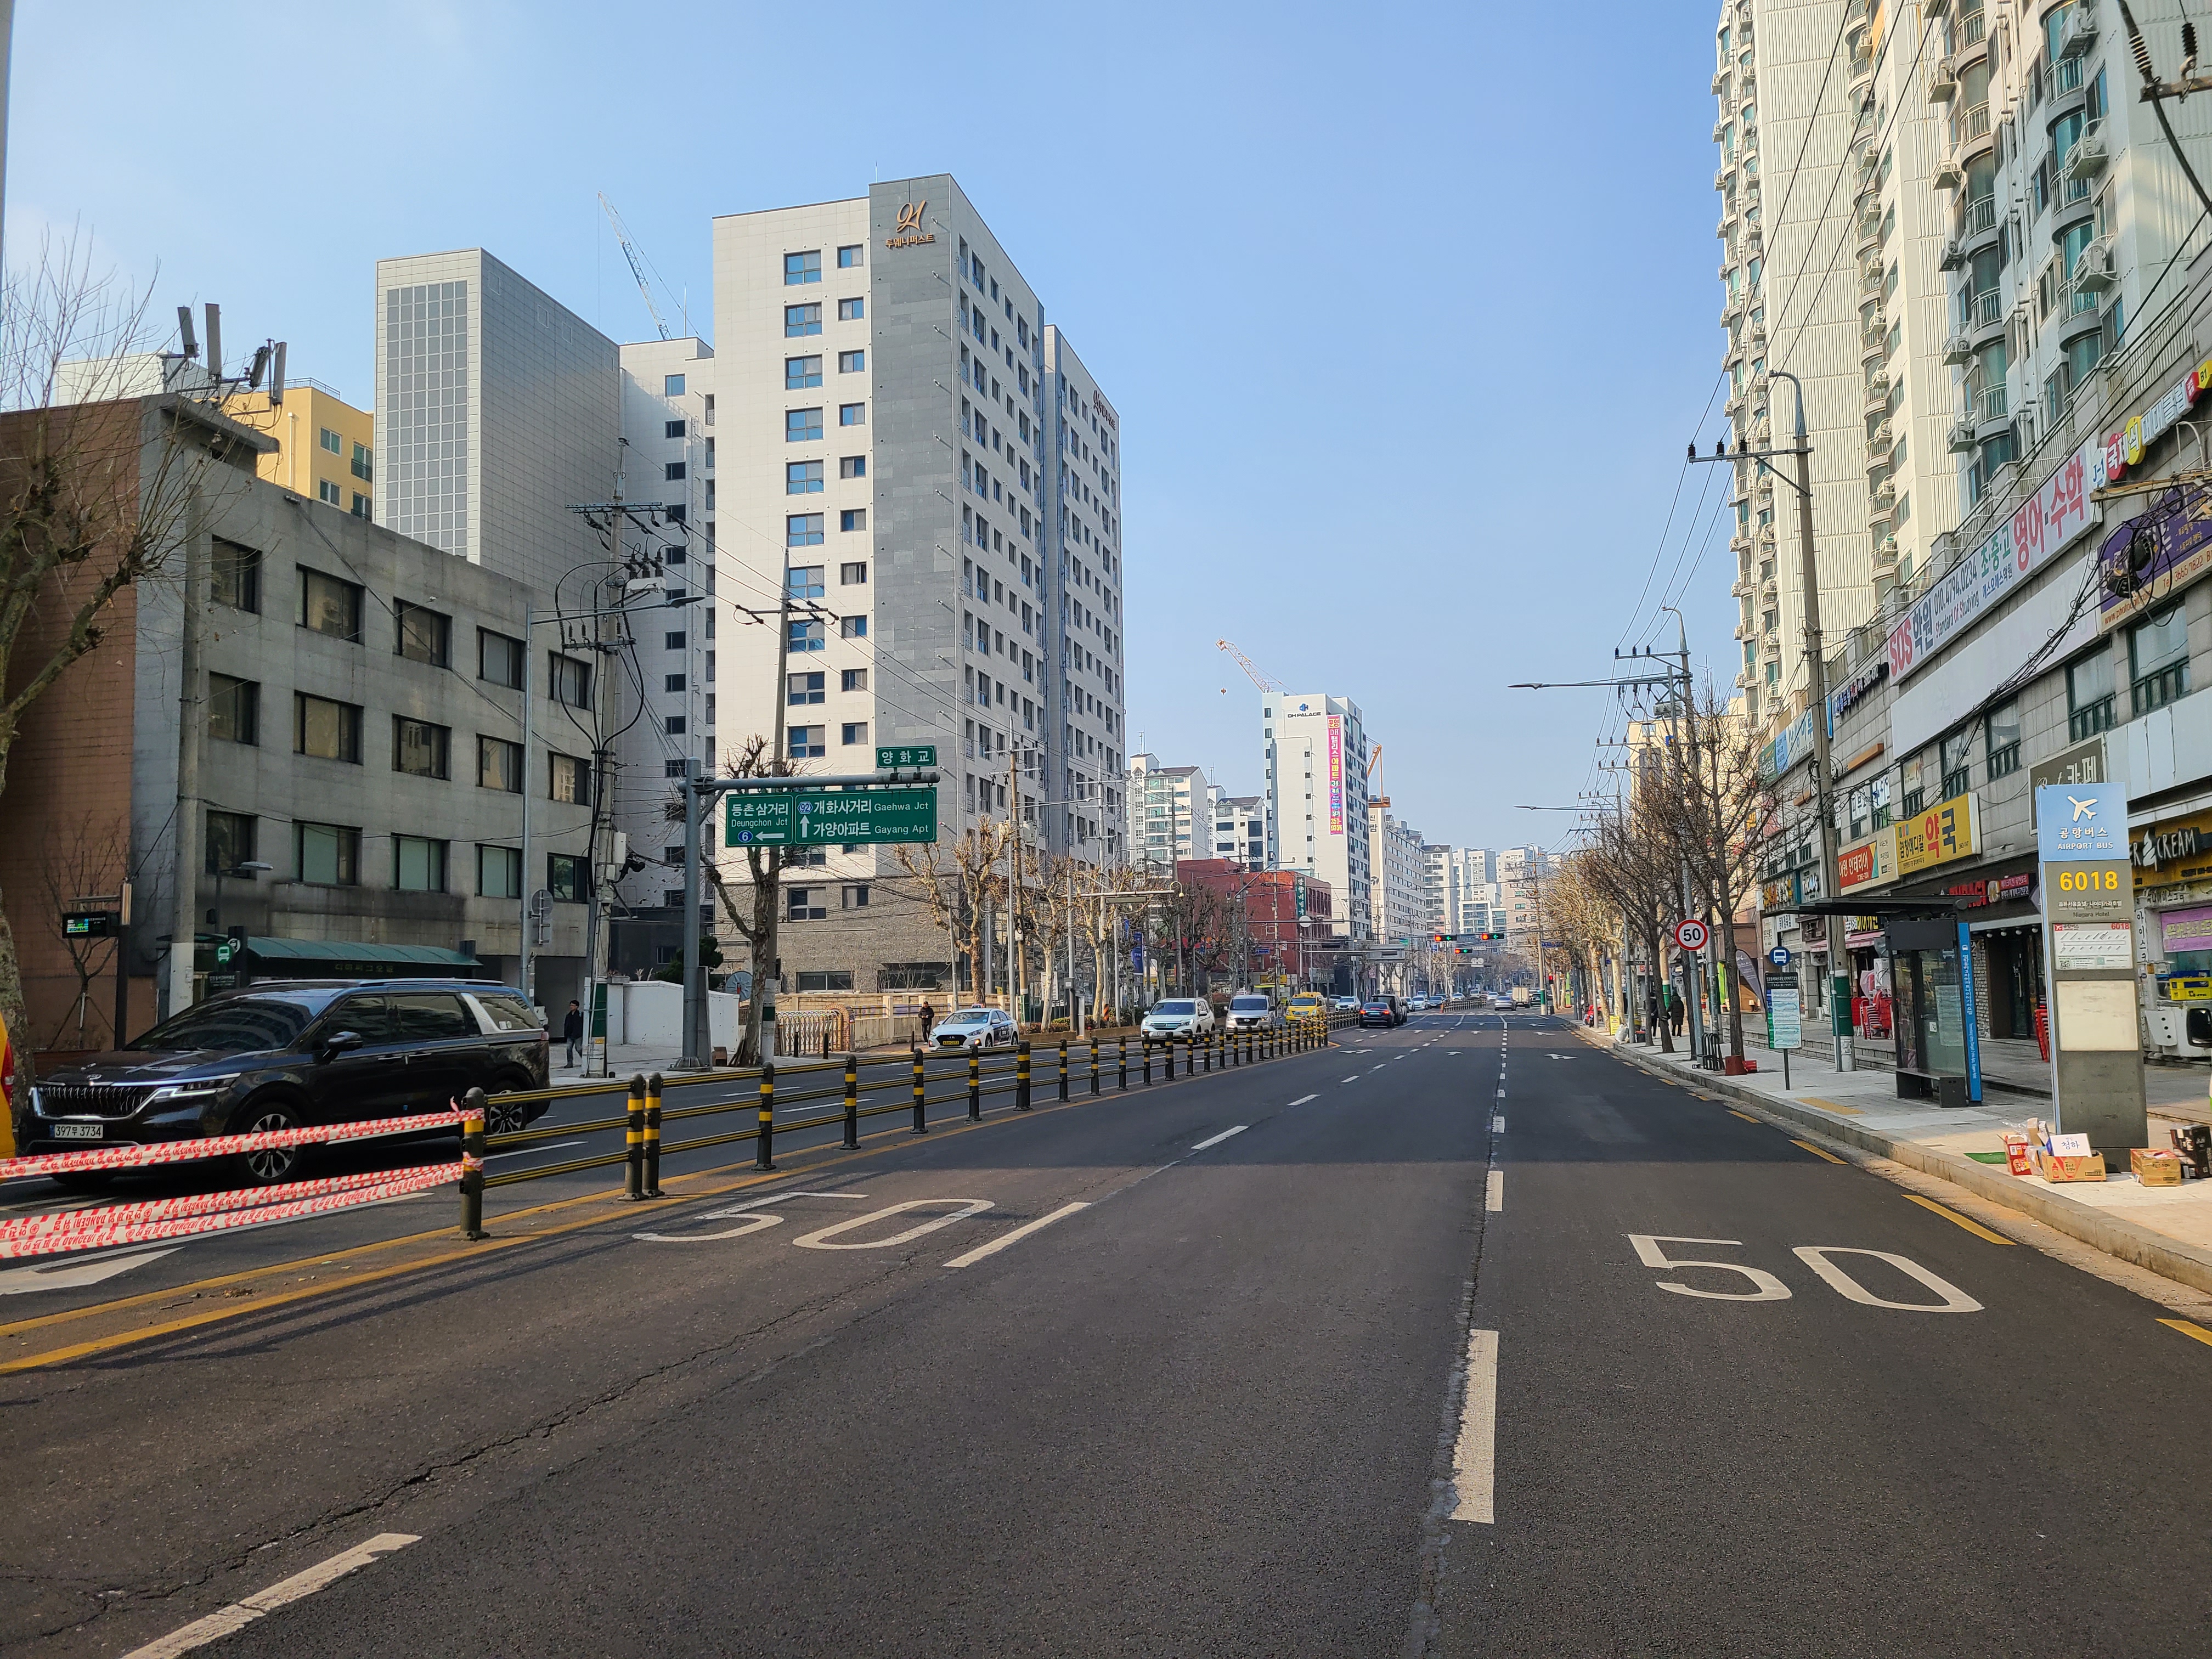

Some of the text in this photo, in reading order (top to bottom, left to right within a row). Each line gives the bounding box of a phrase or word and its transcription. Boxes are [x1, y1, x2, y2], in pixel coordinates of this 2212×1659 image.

[885, 234, 934, 249] 투웨니퍼스트
[1934, 556, 1977, 617] 010.4794.0234
[1982, 561, 2013, 599] 에스오에스학원
[1935, 612, 1954, 639] Standard
[1960, 590, 1979, 618] Studying
[1912, 597, 1934, 656] 학원
[1890, 618, 1912, 677] SOS
[881, 750, 930, 765] 양화교
[731, 802, 789, 816] 등촌삼거리
[800, 803, 811, 812] 92
[814, 799, 872, 815] 개화사거리
[874, 801, 929, 811] Gaehwa Jct
[731, 817, 788, 829] Deungchon Jct
[814, 821, 871, 837] 가양아파트
[874, 824, 929, 837] Gayang Apt
[742, 832, 749, 842] 6
[1925, 808, 1956, 859] 약국
[2058, 827, 2109, 839] 공항버스
[1900, 833, 1924, 859] 염창메디칼
[2057, 842, 2094, 850] AIRPORT
[2157, 829, 2196, 859] CREAM
[1848, 851, 1868, 875] 인테리어
[2059, 870, 2118, 891] 6018
[1682, 927, 1702, 943] 50
[56, 1126, 101, 1137] 397무 3734
[2061, 1141, 2080, 1150] 청하
[74, 1214, 106, 1228] DANGER!
[631, 1192, 996, 1250] 50
[1628, 1233, 1986, 1313] 50
